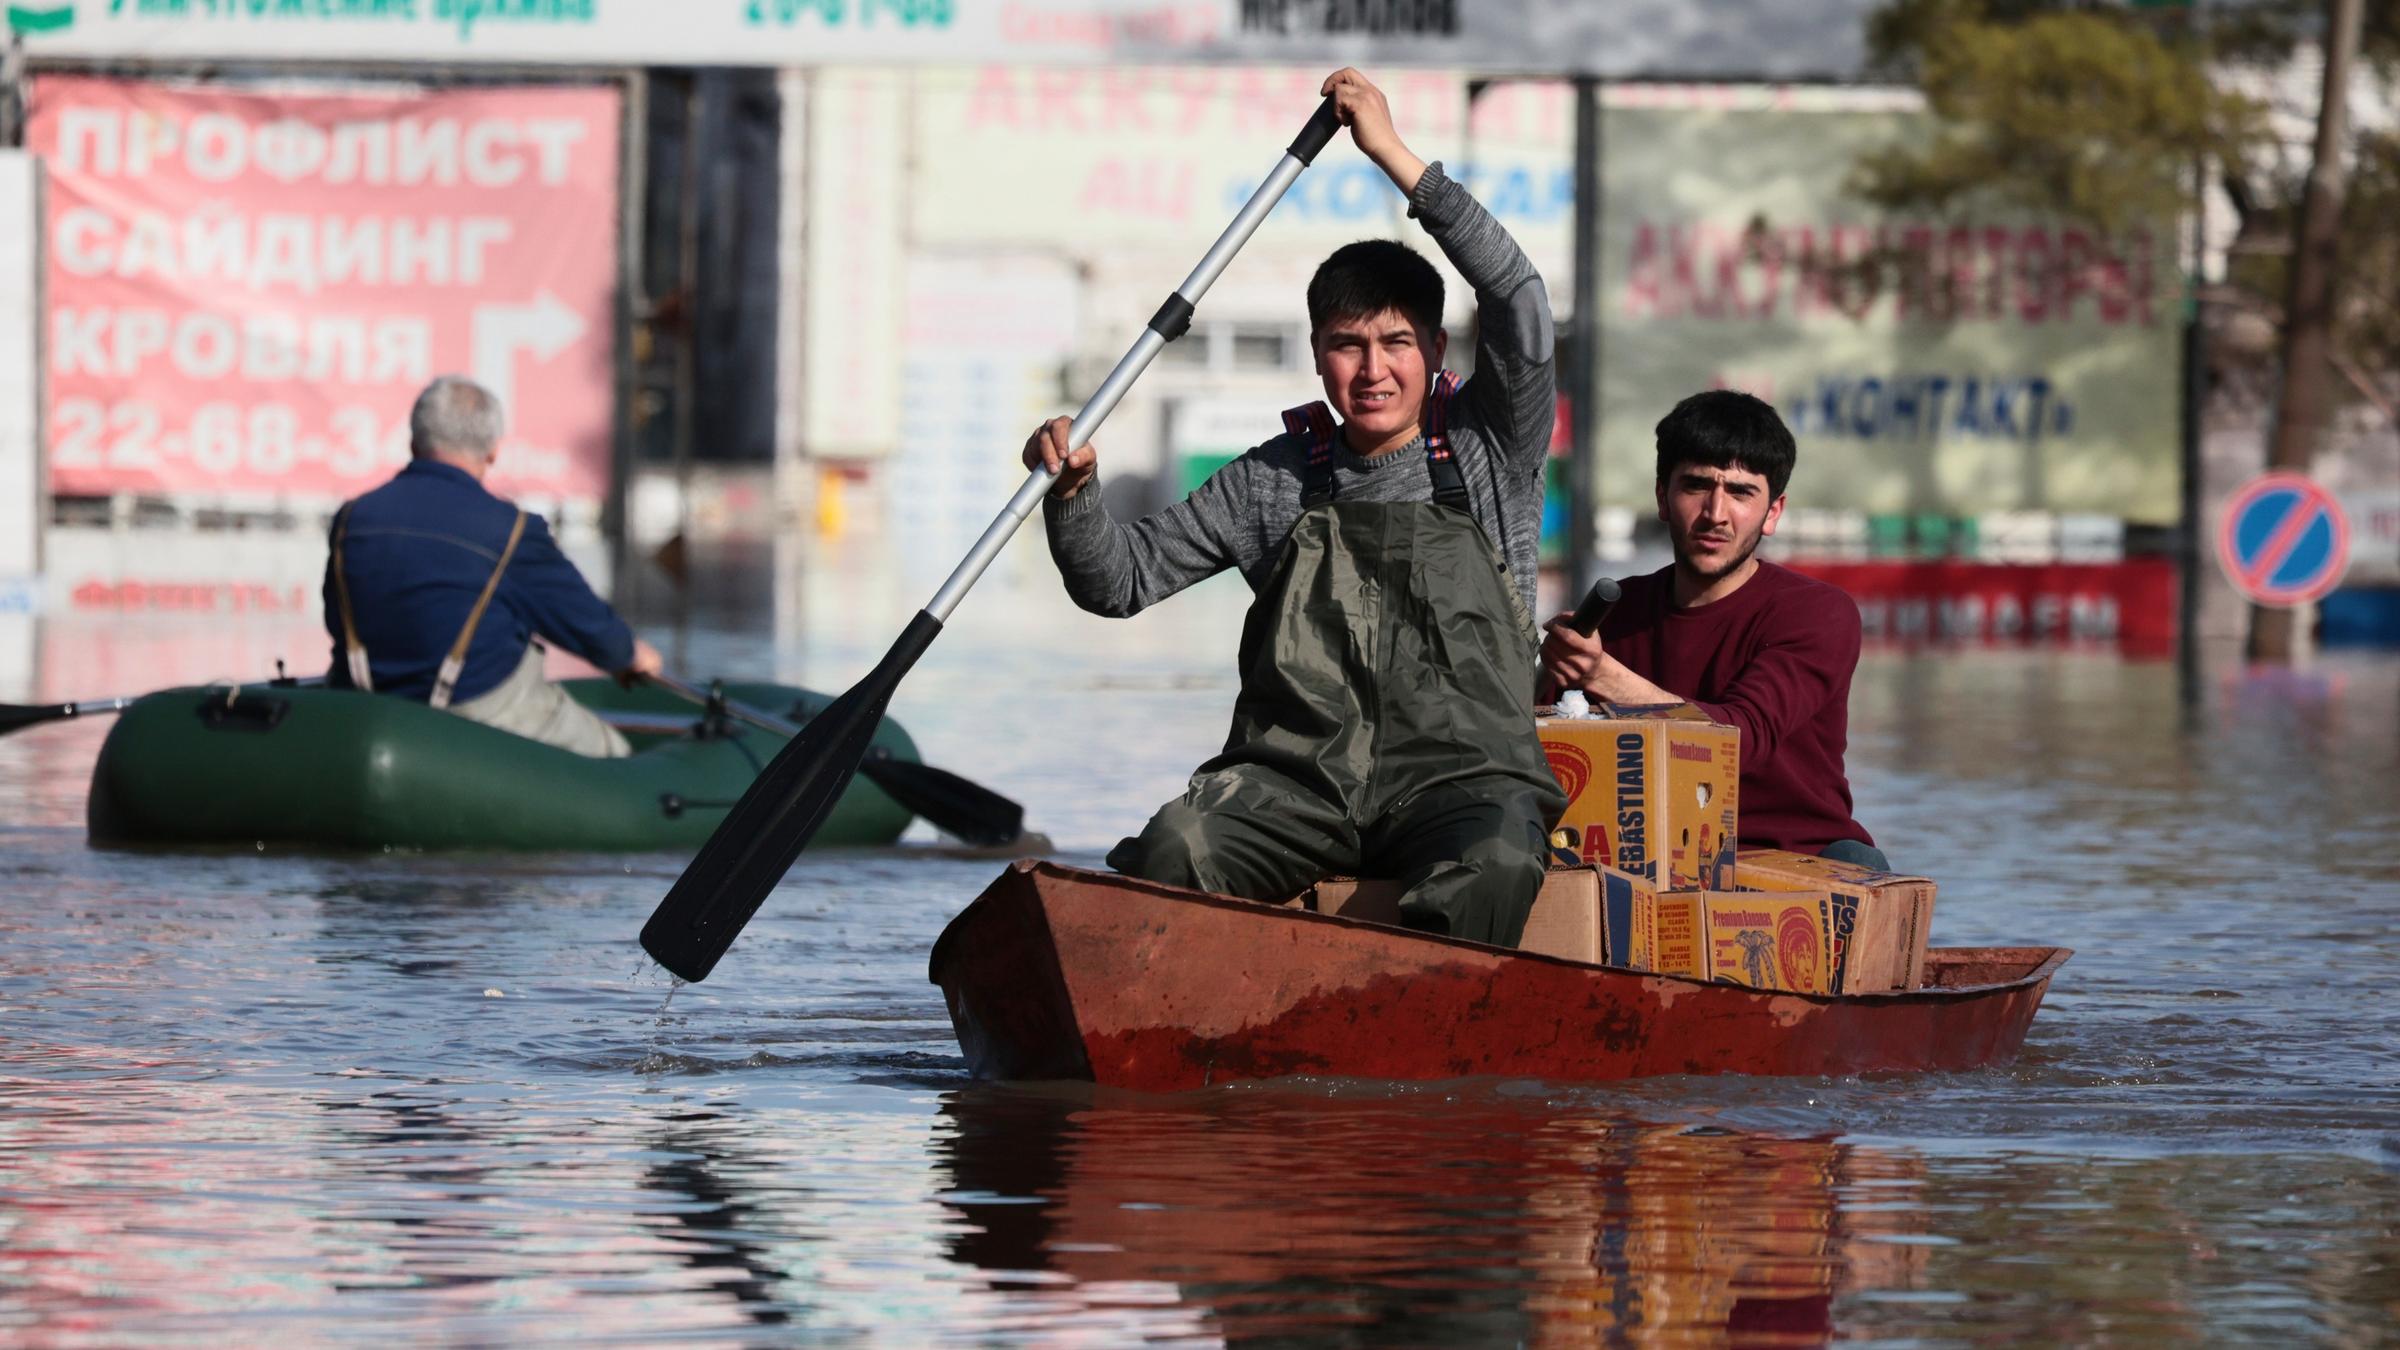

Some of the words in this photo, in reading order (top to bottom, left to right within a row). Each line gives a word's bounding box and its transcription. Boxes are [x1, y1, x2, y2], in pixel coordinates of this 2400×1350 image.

[55, 107, 588, 188] ПРОФЛИСТ
[52, 200, 514, 294] САЙДИНГ
[52, 306, 432, 383] КРОВЛЯ
[1617, 733, 1646, 875] EBASTIANO
